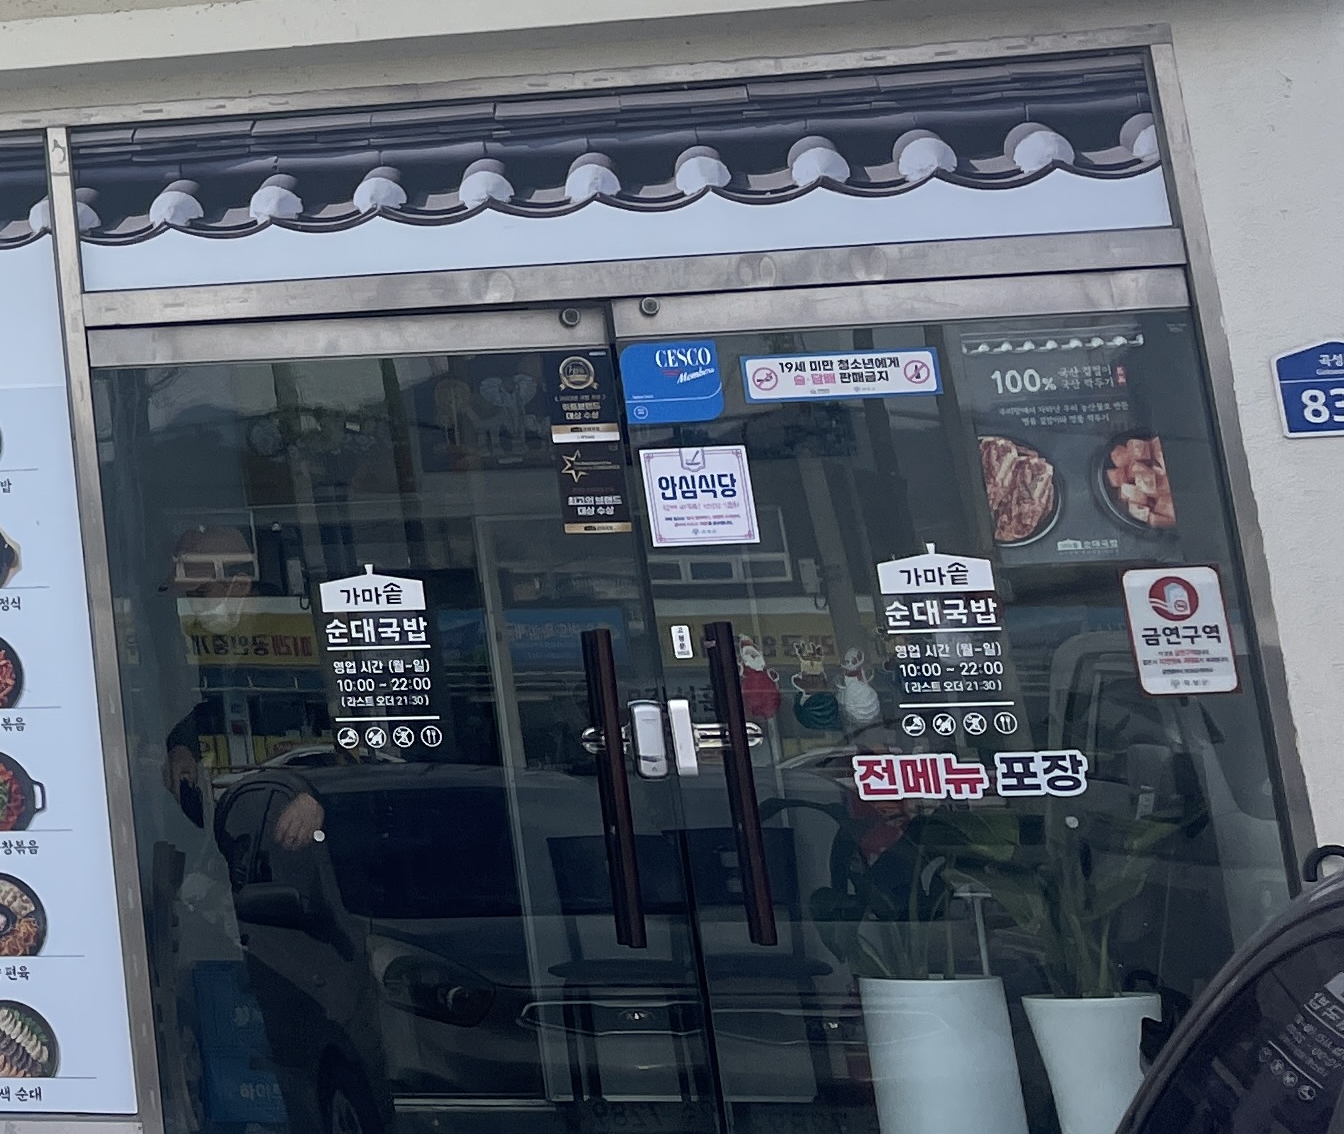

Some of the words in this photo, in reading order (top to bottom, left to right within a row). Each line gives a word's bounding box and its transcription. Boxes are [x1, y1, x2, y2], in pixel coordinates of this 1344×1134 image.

[655, 347, 711, 368] CESCO
[778, 361, 807, 373] 19세
[809, 360, 834, 372] 미만
[837, 356, 900, 371] 청소년에게
[676, 367, 715, 385] Members
[839, 371, 889, 384] 판매금지
[657, 473, 737, 501] 안심식당
[898, 561, 969, 586] 가마솥
[339, 582, 403, 605] 가마솥
[885, 597, 998, 626] 순대국밥
[325, 616, 428, 644] 순대국밥
[1141, 624, 1222, 646] 금연구역
[894, 644, 921, 659] 영업
[924, 643, 950, 658] 시간
[333, 660, 357, 674] 영업
[360, 660, 384, 674] 시간
[899, 663, 942, 677] 10:00
[959, 661, 1004, 676] 22:00
[336, 678, 375, 692] 10:00
[390, 677, 431, 691] 22:00
[856, 756, 986, 797] 전메뉴
[998, 753, 1084, 793] 포장
[4, 965, 31, 981] 편육
[14, 1086, 43, 1102] 순대
